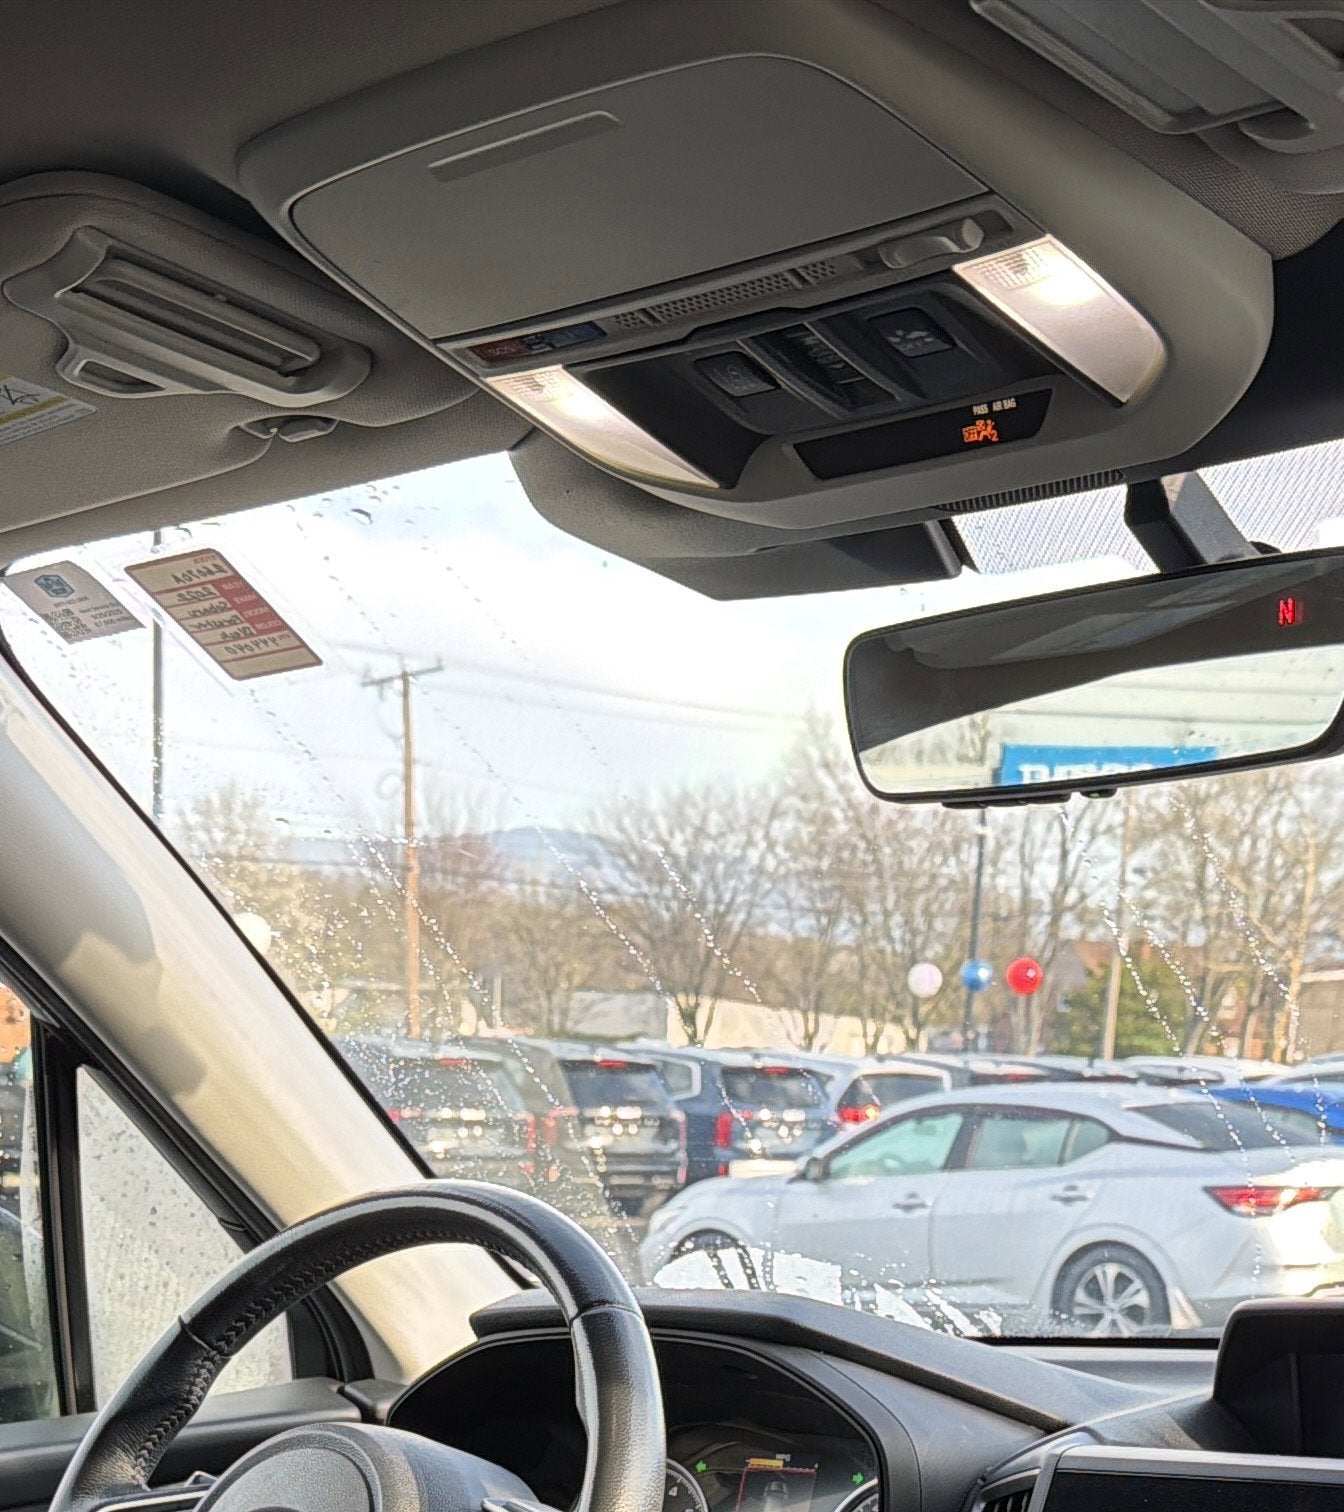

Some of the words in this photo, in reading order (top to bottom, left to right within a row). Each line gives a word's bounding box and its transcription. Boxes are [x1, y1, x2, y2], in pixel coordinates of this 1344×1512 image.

[972, 403, 989, 416] PASS
[1003, 397, 1017, 410] BAG
[1278, 598, 1296, 626] N
[668, 1486, 678, 1497] 4
